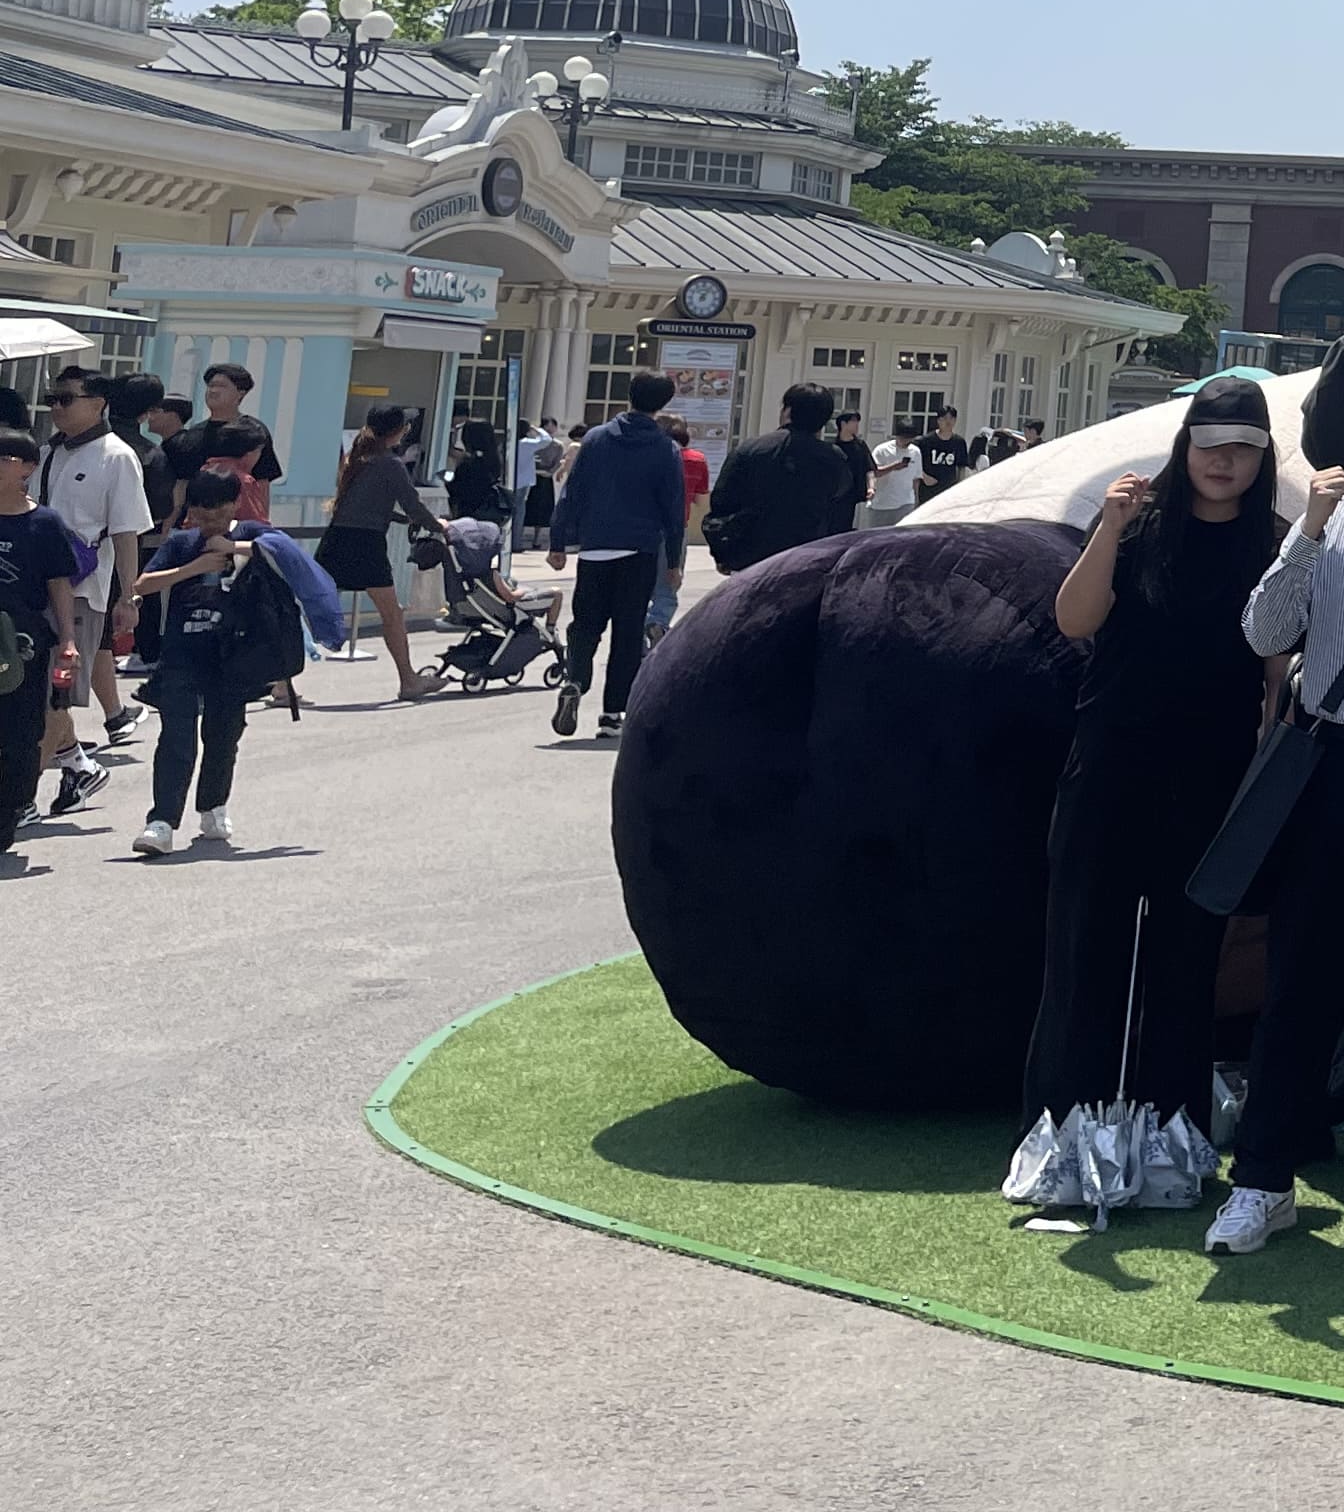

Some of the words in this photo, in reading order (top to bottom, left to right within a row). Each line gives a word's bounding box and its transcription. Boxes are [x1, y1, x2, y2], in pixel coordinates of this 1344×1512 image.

[412, 266, 468, 300] SNACK
[656, 323, 705, 335] ORIENTAL
[707, 326, 748, 337] STATION
